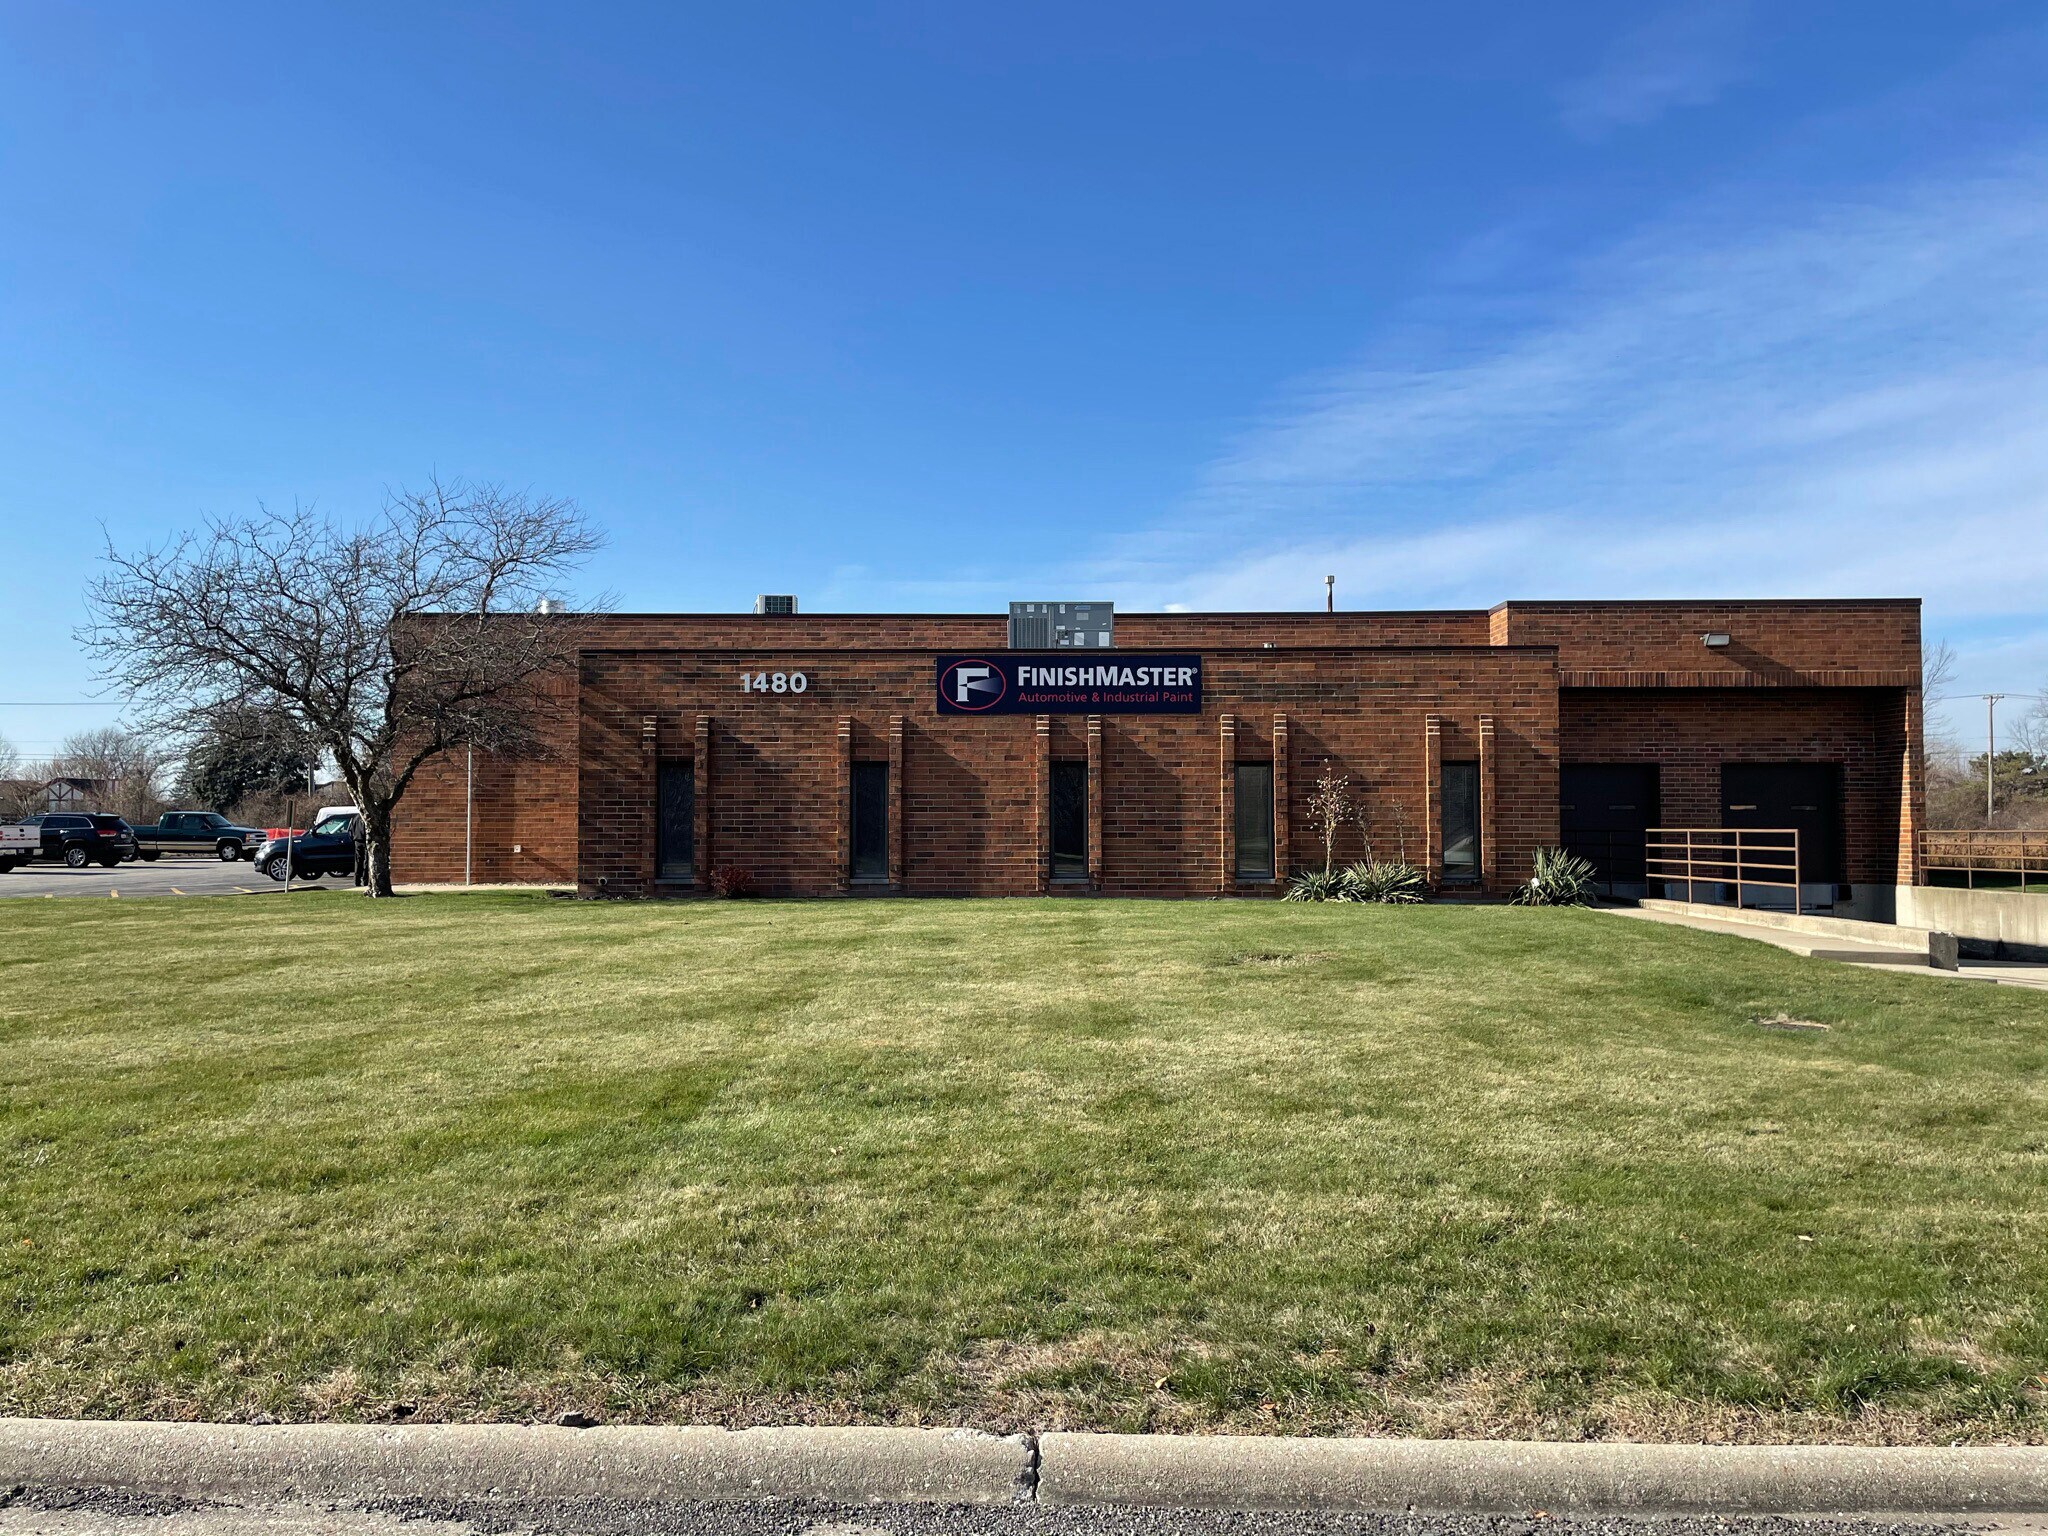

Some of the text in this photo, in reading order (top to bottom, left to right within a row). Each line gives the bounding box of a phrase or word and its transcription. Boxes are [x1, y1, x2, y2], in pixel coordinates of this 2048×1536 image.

[740, 672, 807, 694] 1480
[1018, 691, 1193, 703] Automotive & Industrial Paint
